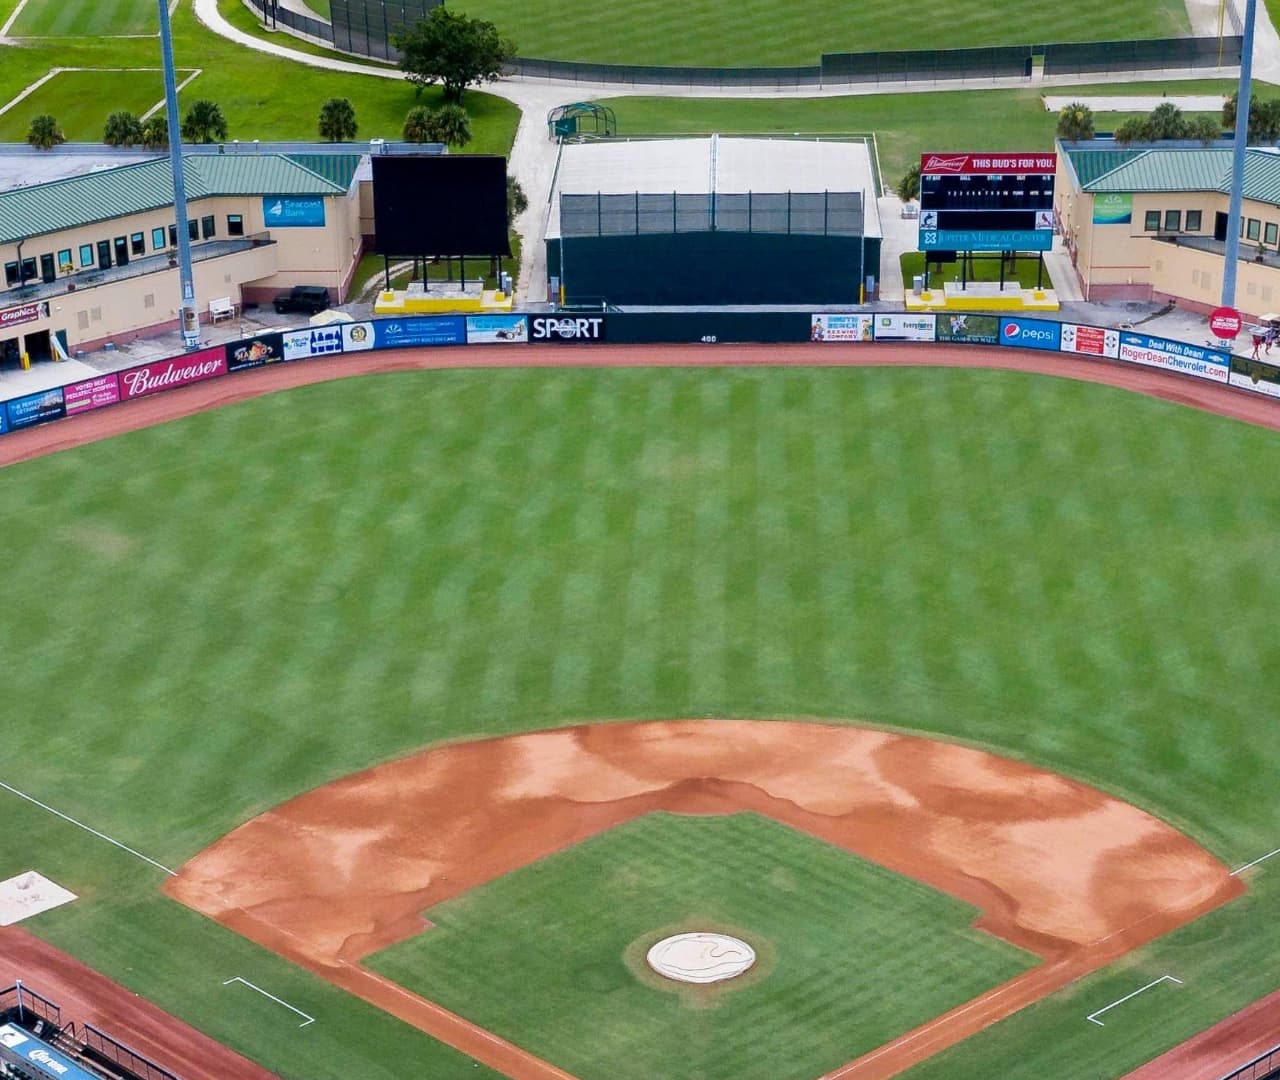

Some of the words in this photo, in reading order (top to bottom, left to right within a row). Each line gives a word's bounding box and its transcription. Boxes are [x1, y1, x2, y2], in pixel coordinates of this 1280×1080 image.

[972, 159, 990, 168] THIS
[992, 159, 1016, 168] BUD'S
[1018, 159, 1034, 168] FOR
[1036, 158, 1055, 168] YOU.
[972, 232, 1009, 241] MEDICAL
[1012, 232, 1046, 241] CENTER
[1, 307, 36, 321] Graphics.
[533, 318, 603, 338] SPORT
[1022, 329, 1054, 340] pepsi
[701, 335, 717, 343] 400
[1148, 339, 1164, 350] Deal
[1166, 342, 1182, 354] With
[1183, 346, 1204, 360] Dean!
[1122, 346, 1226, 378] RogerDeanChevrolet.com
[124, 358, 223, 396] Budweiser
[27, 1049, 68, 1074] Corona
